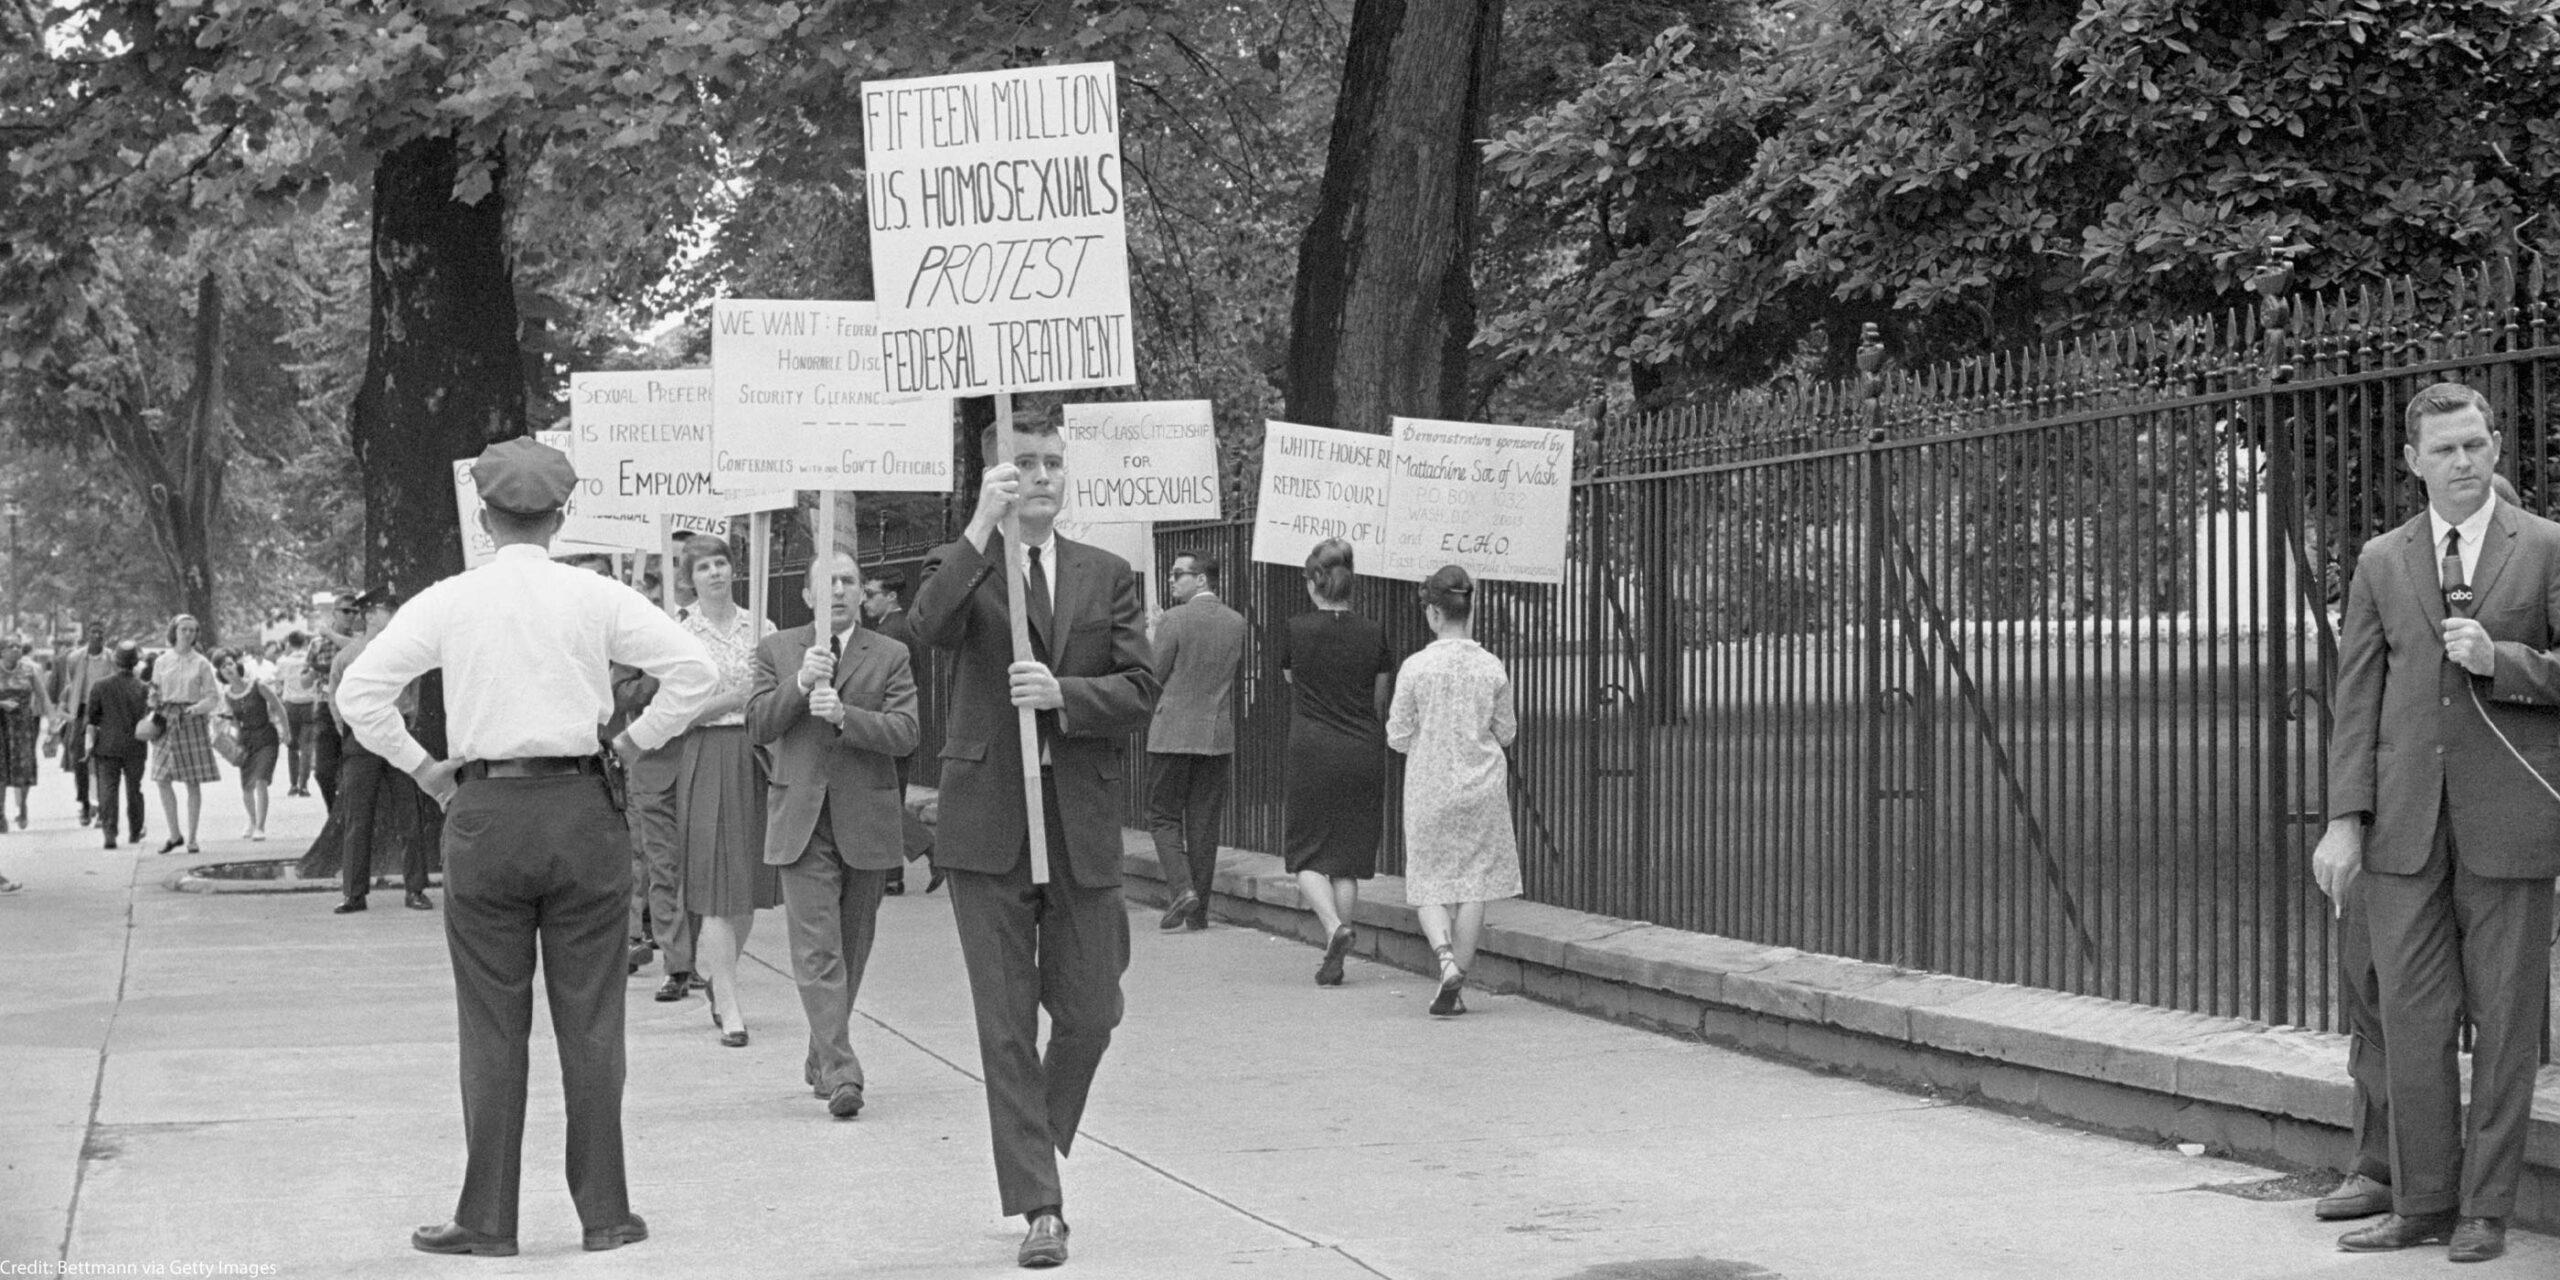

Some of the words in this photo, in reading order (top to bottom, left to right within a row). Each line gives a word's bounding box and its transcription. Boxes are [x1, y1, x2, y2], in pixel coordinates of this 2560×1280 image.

[867, 84, 979, 151] FIFTEEN
[992, 73, 1113, 141] MILLION
[871, 170, 911, 231] U.S.
[921, 153, 1118, 229] HOMOSEXUALS
[906, 235, 1104, 309] PROTEST
[719, 310, 755, 335] WE
[837, 317, 878, 337] FEDERA
[848, 349, 881, 371] DISC
[882, 325, 987, 392] FEDERAL
[988, 315, 1125, 385] TREATMENT
[578, 381, 638, 404] SEXUAL
[739, 384, 803, 405] SECURITY
[814, 383, 882, 405] CLEARANC
[581, 424, 599, 442] IS
[610, 424, 712, 442] IRRELEVANT
[1140, 414, 1209, 440] CITIZENSHIP
[1280, 436, 1326, 460] WHITE
[1330, 442, 1375, 467] HOUSE
[1403, 422, 1492, 446] Demonstration
[1496, 432, 1550, 454] sponsored
[1547, 434, 1565, 465] by
[882, 450, 947, 476] OFFICIALS
[1123, 455, 1152, 469] FOR
[1395, 454, 1467, 480] Mattachine
[1499, 458, 1514, 490] of
[579, 478, 603, 496] TO
[620, 459, 723, 497] EMPLOYM
[1076, 475, 1214, 508] HOMOSEXUALS
[1273, 475, 1320, 499] REPLIES
[1324, 481, 1342, 501] TO
[1344, 484, 1375, 506] OUR
[1377, 488, 1386, 507] L
[671, 513, 728, 536] ITIZENS
[1352, 523, 1372, 541] OF
[1376, 526, 1386, 544] U
[2451, 589, 2473, 600] abc
